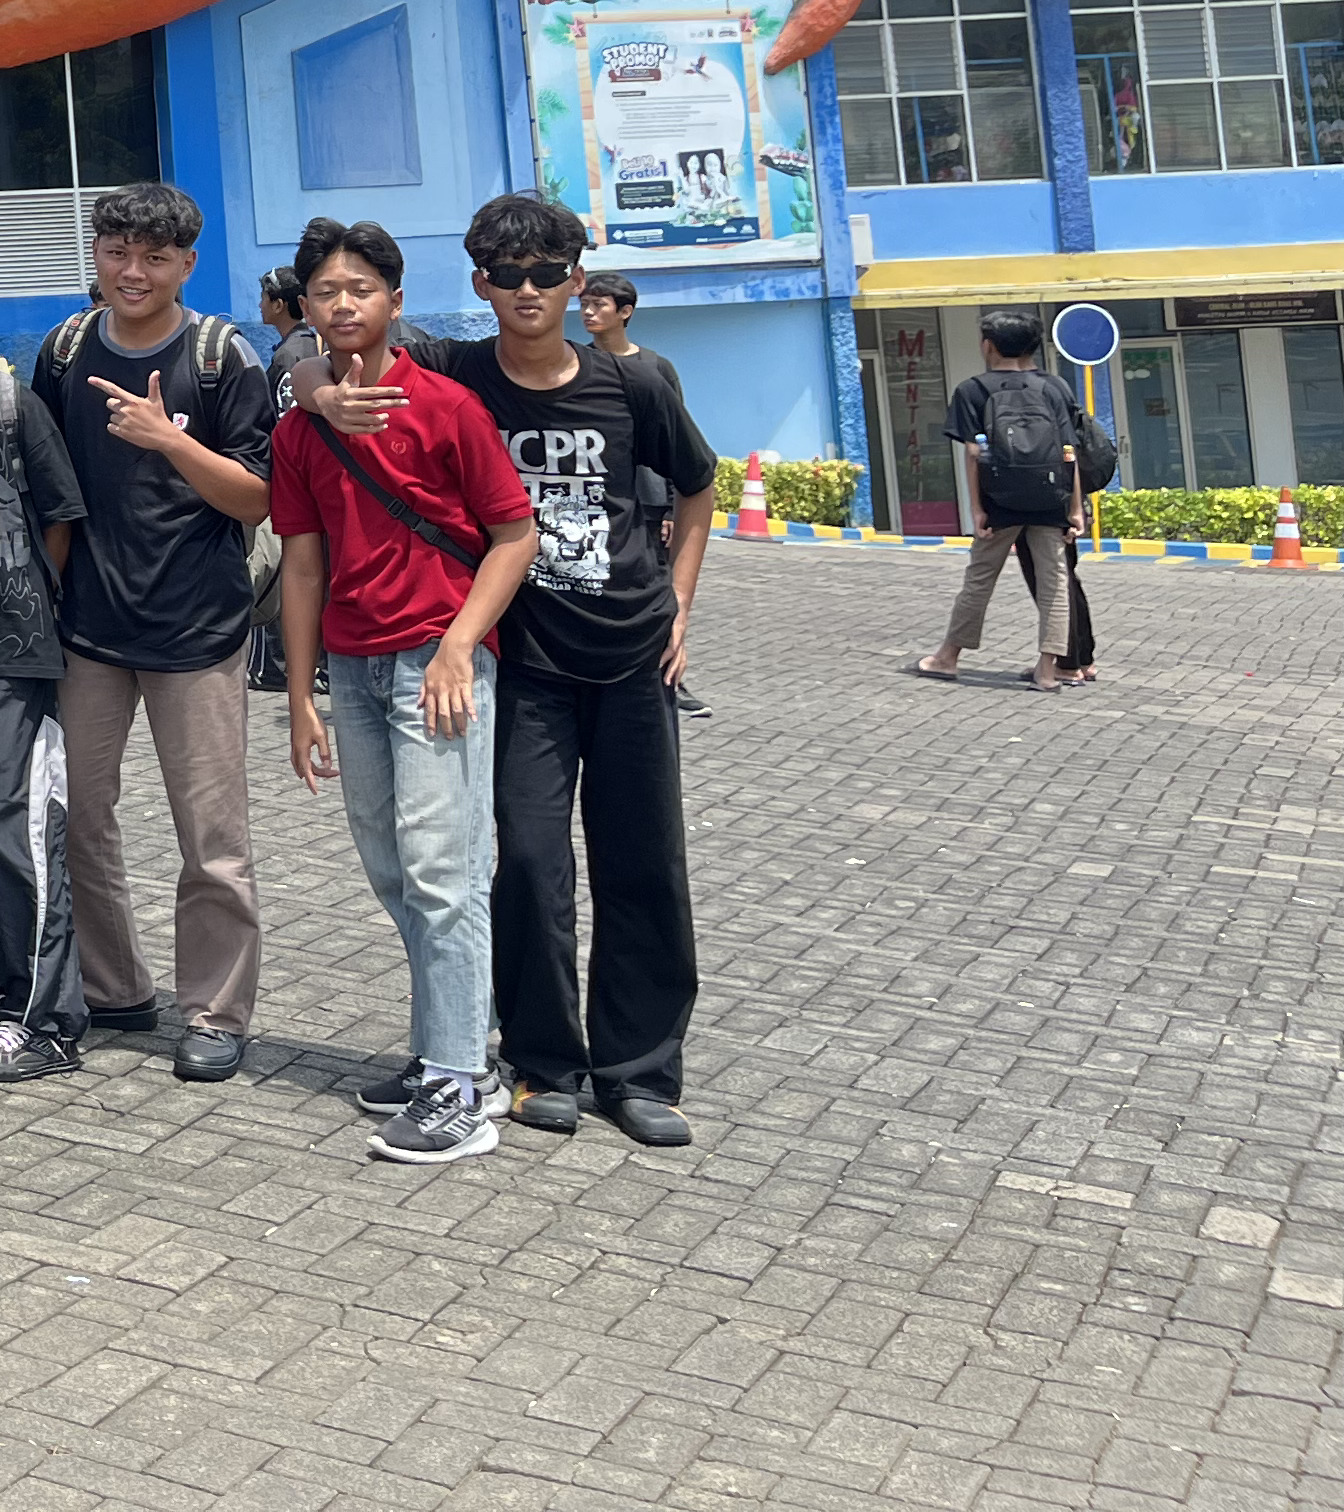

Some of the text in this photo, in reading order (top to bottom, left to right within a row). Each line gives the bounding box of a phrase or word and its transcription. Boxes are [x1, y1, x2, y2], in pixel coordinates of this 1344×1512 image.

[602, 42, 668, 63] STUDENT
[618, 167, 661, 181] Gratis
[498, 428, 609, 474] CPR
